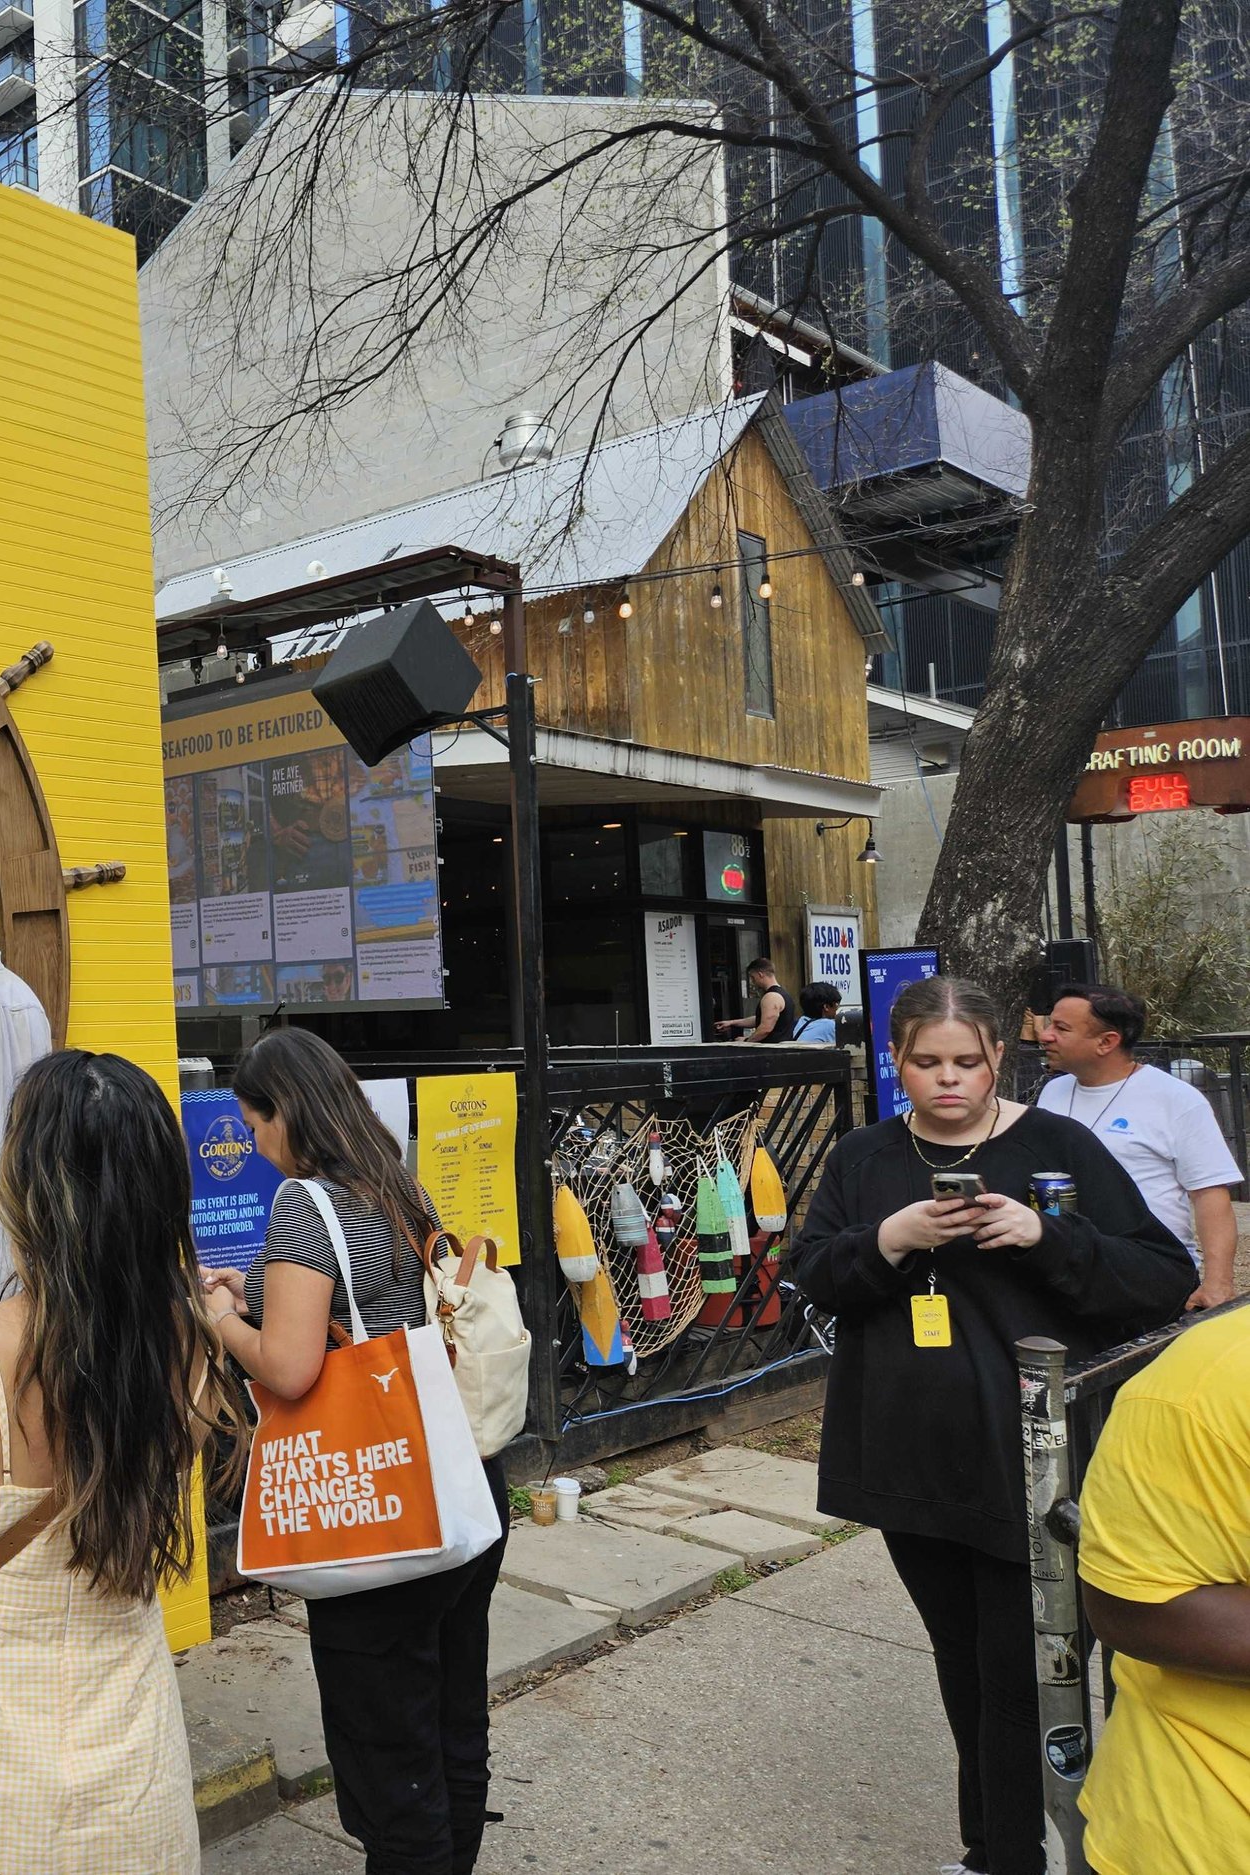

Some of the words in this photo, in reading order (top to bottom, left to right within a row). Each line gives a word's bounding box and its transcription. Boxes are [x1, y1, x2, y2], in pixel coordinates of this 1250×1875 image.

[162, 733, 212, 761] SEAFOOD
[217, 729, 233, 749] TO
[238, 723, 253, 745] BE
[258, 709, 322, 741] FEATURED
[1085, 743, 1170, 770] RAFTING
[1179, 737, 1241, 761] ROOM
[272, 768, 285, 782] AYE
[1130, 776, 1188, 794] FULL
[1130, 791, 1189, 812] BAR
[409, 861, 431, 874] FISH
[658, 915, 683, 933] ASADOR
[820, 953, 851, 975] TACOS
[192, 1199, 206, 1211] THIS
[208, 1196, 229, 1208] EVENT
[230, 1194, 237, 1206] IS
[238, 1193, 258, 1205] BEING
[189, 1209, 238, 1225] HOTOGRAPHED
[238, 1206, 265, 1218] AND/OR
[196, 1225, 217, 1237] VIDEO
[219, 1221, 255, 1235] RECORDED.
[261, 1430, 322, 1465] WHAT
[260, 1451, 350, 1488] STARTS
[356, 1437, 412, 1473] HERE
[259, 1473, 375, 1512] CHANGES
[260, 1508, 311, 1536] THE
[317, 1495, 403, 1530] WORLD
